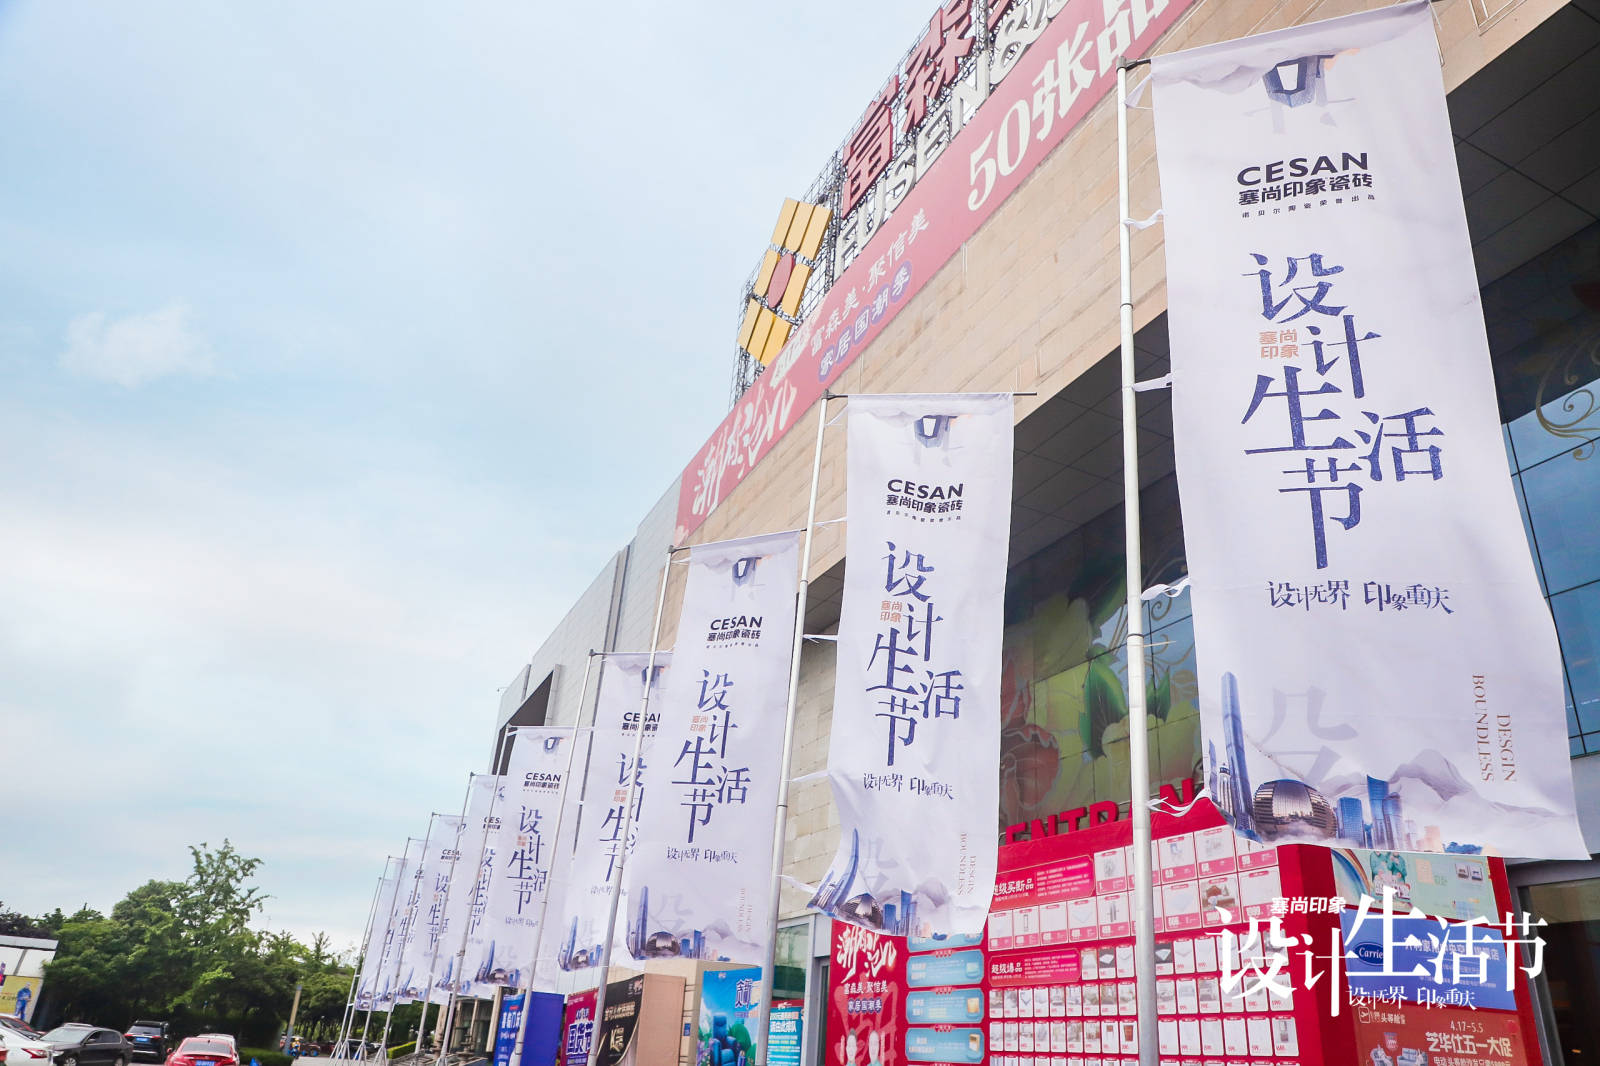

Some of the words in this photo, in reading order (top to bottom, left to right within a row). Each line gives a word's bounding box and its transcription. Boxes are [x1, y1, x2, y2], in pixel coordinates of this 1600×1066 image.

[1237, 152, 1368, 186] CESAN
[1239, 173, 1373, 205] 塞尚印象瓷砖
[887, 479, 963, 500] CESAN
[886, 495, 963, 513] 塞尚印象瓷砖
[1265, 581, 1350, 611] 设计无界
[1363, 582, 1453, 614] 印象重庆
[710, 615, 762, 631] CESAN
[525, 772, 562, 782] CESAN
[1004, 778, 1195, 846] ENTRN
[1425, 1031, 1513, 1057] 芝华仕五一大促
